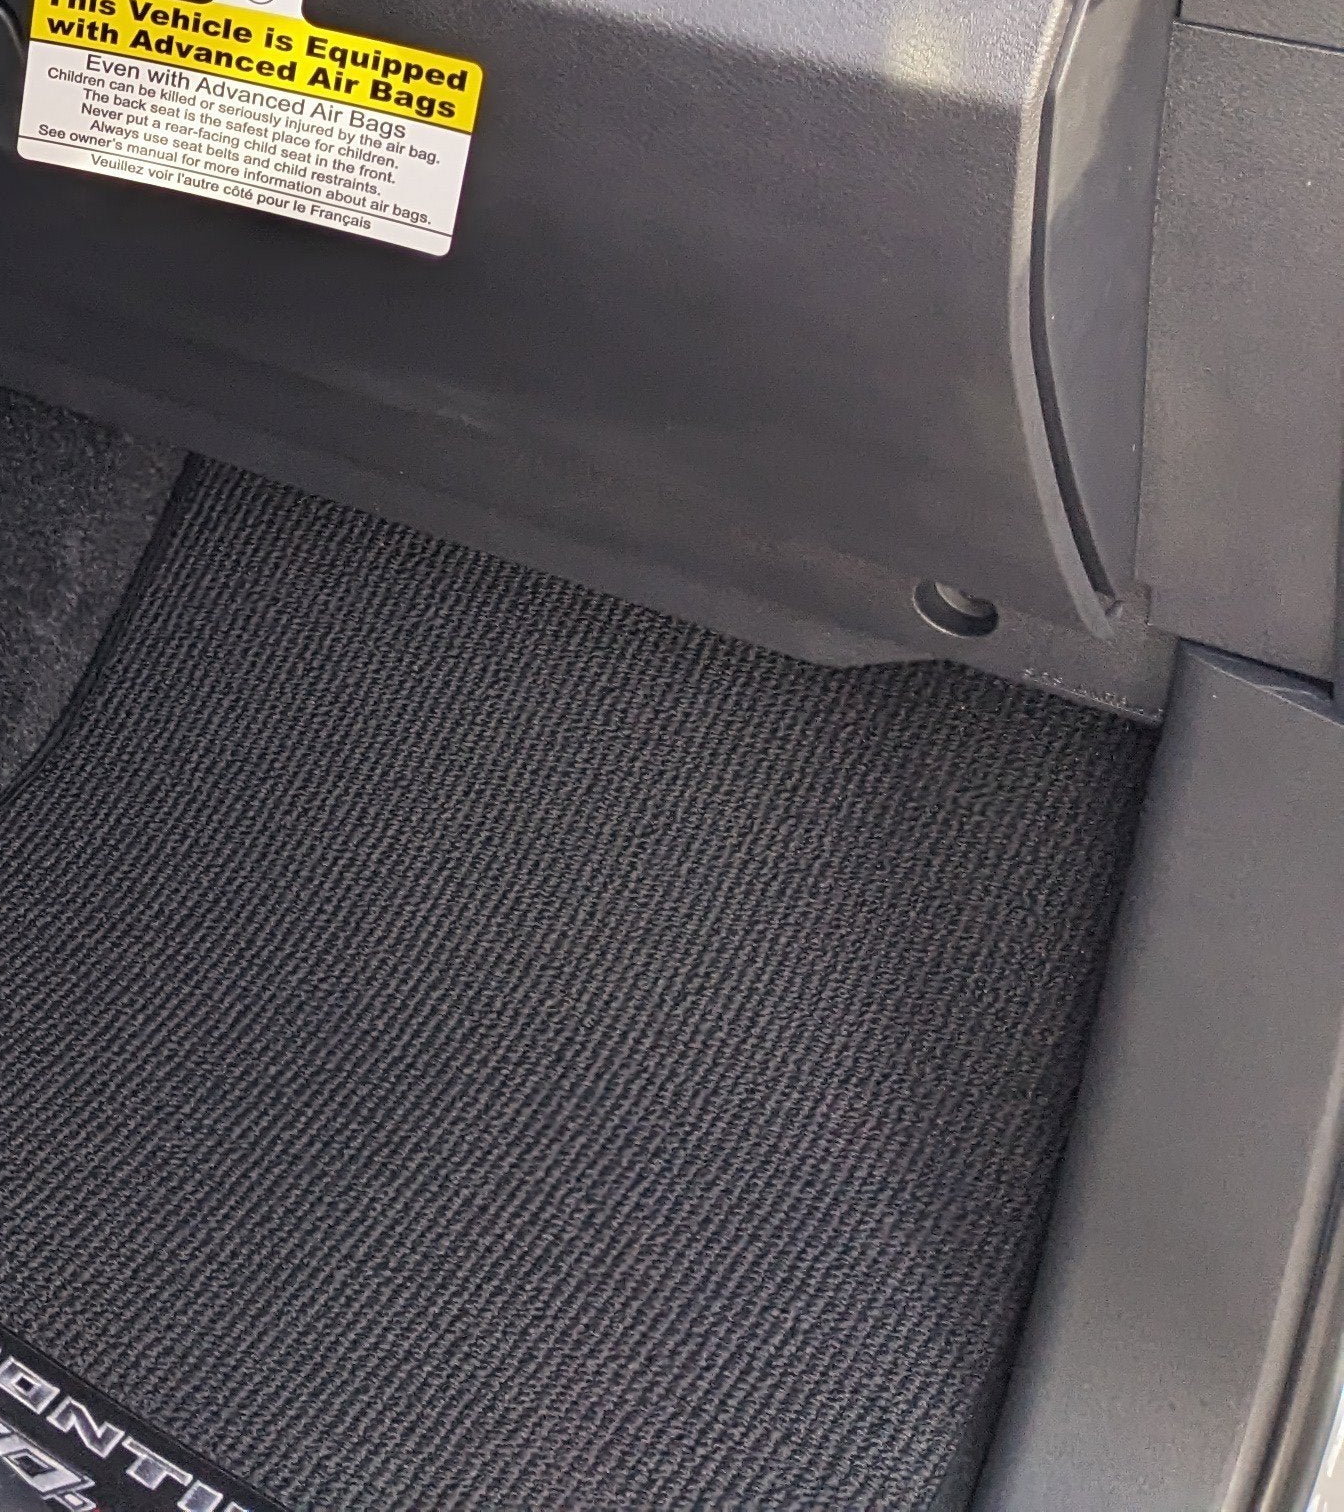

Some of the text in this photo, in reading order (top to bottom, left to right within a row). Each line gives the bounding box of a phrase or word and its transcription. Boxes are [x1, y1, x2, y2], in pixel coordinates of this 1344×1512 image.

[47, 17, 456, 118] with Advanced Air Bags
[129, 0, 252, 43] Vehicle
[264, 28, 293, 52] is
[306, 36, 468, 92] Equipped
[48, 67, 440, 165] Children can be killed or seriously injured by the air bag.
[83, 88, 398, 169] The back seat is the safest place for children.
[86, 54, 406, 139] Even with Advanced Air Bags
[38, 124, 431, 225] See owner's manual for more information about air bags.
[81, 102, 395, 184] Never put a rear-facing child seat in the front.
[90, 120, 380, 196] Always use seat belts and child restraints.
[91, 154, 371, 229] Veuillez voir l'autre côté pour le Français
